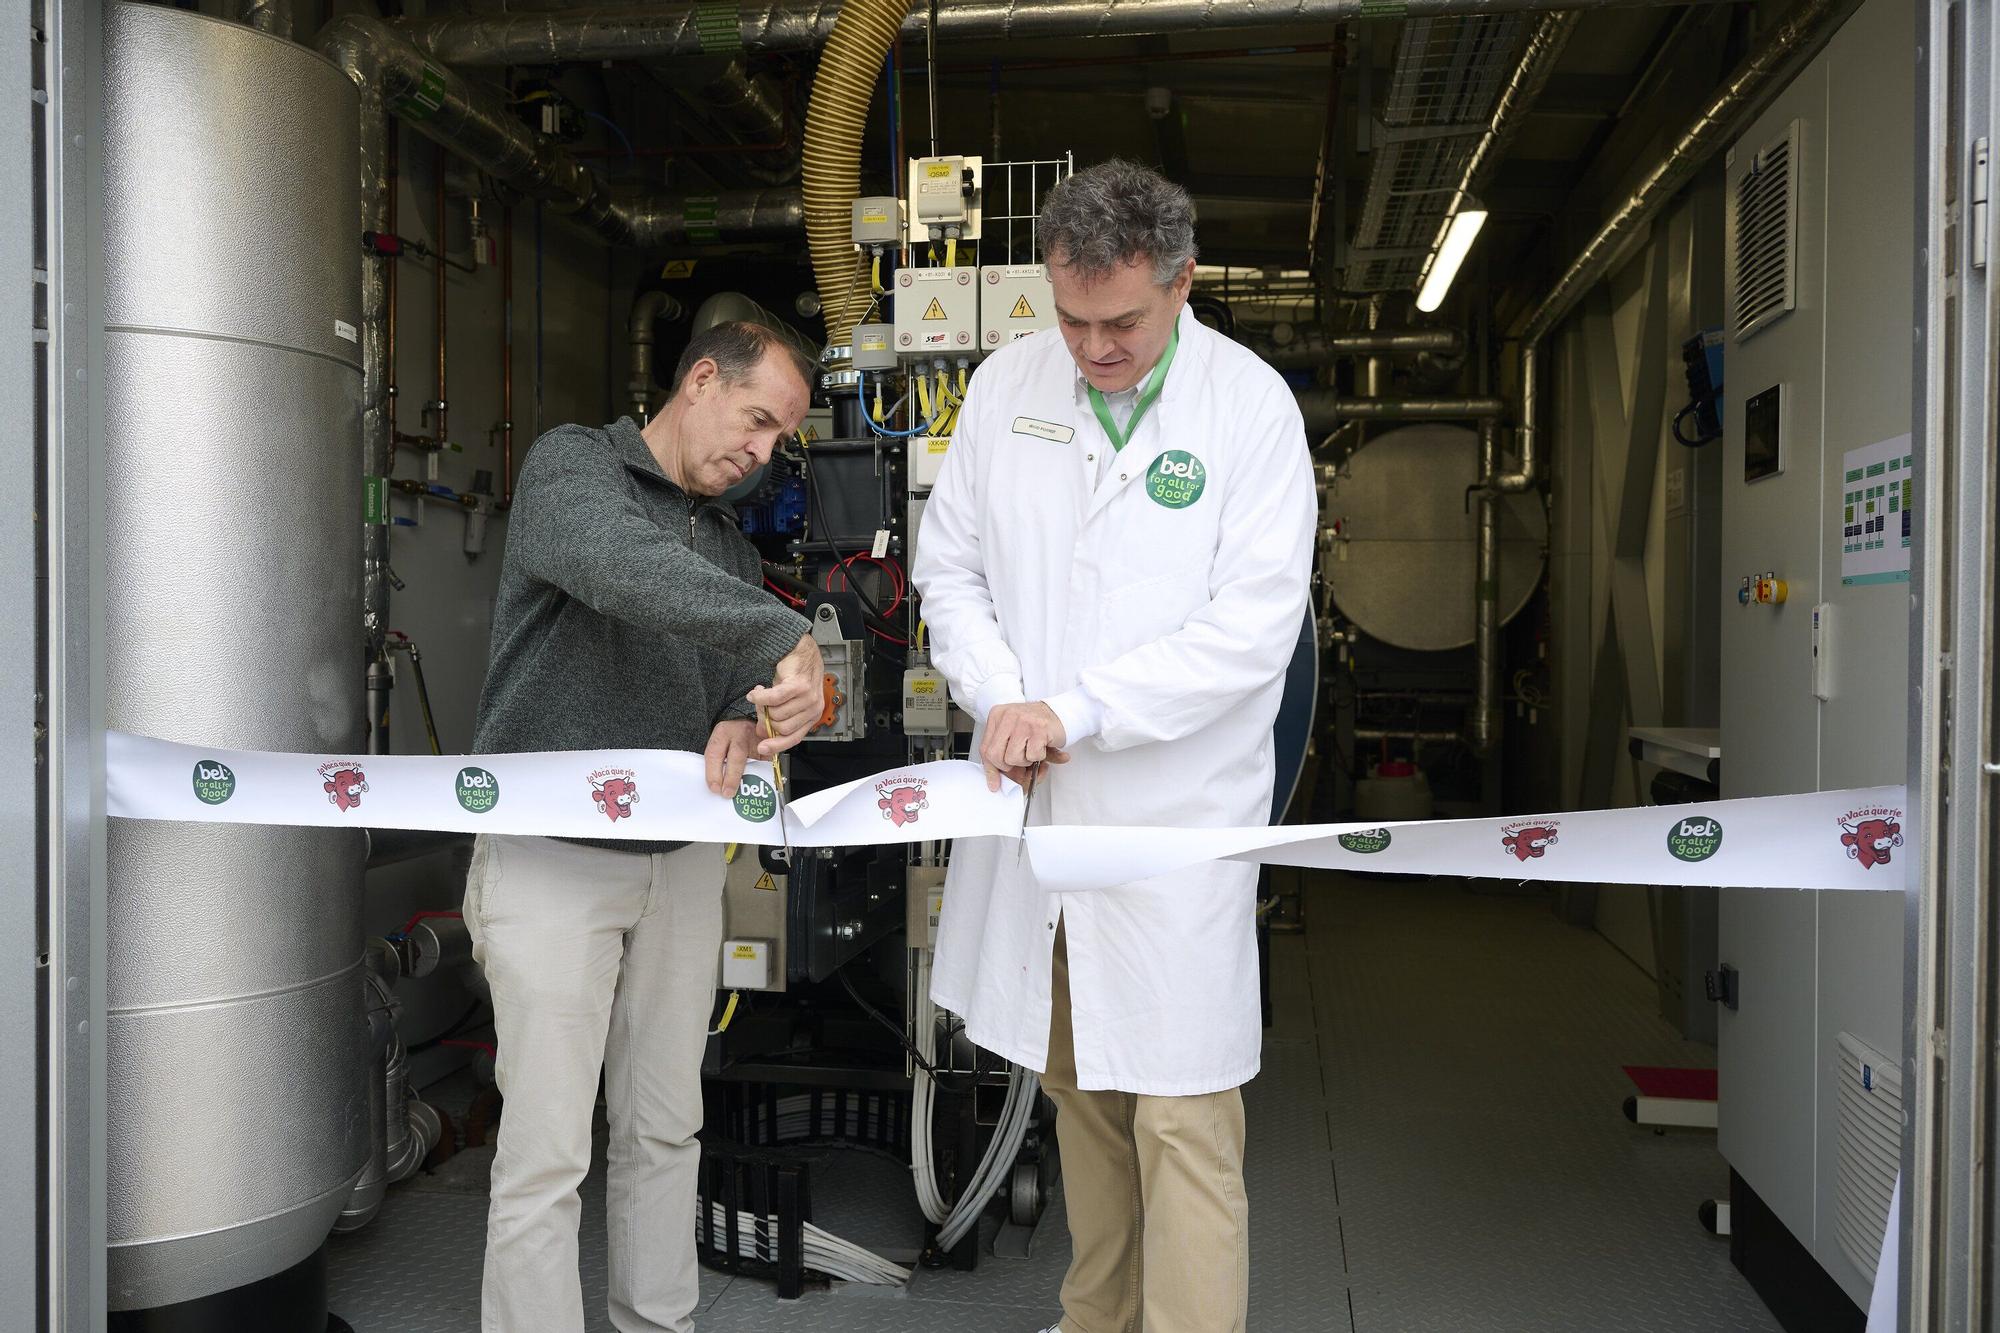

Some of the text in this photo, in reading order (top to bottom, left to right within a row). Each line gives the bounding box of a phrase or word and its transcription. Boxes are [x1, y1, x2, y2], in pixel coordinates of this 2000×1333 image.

[1160, 454, 1196, 480] bel
[1150, 472, 1200, 490] for all for
[1154, 484, 1192, 502] good
[322, 762, 338, 770] Vaca
[198, 764, 228, 780] bel
[592, 770, 610, 778] Vaca
[196, 779, 208, 788] for
[210, 780, 222, 790] all
[462, 770, 492, 788] bel
[882, 777, 902, 786] Vaca
[201, 788, 228, 798] good
[459, 786, 471, 796] for
[472, 788, 486, 797] all
[740, 778, 768, 798] bel
[465, 796, 492, 806] good
[736, 795, 748, 804] for
[750, 798, 763, 807] all
[742, 804, 770, 816] good
[1846, 809, 1869, 819] Vaca
[1680, 820, 1714, 836] bel
[1347, 841, 1380, 850] good
[1671, 835, 1686, 844] for
[1688, 837, 1704, 846] all
[1676, 844, 1711, 855] good
